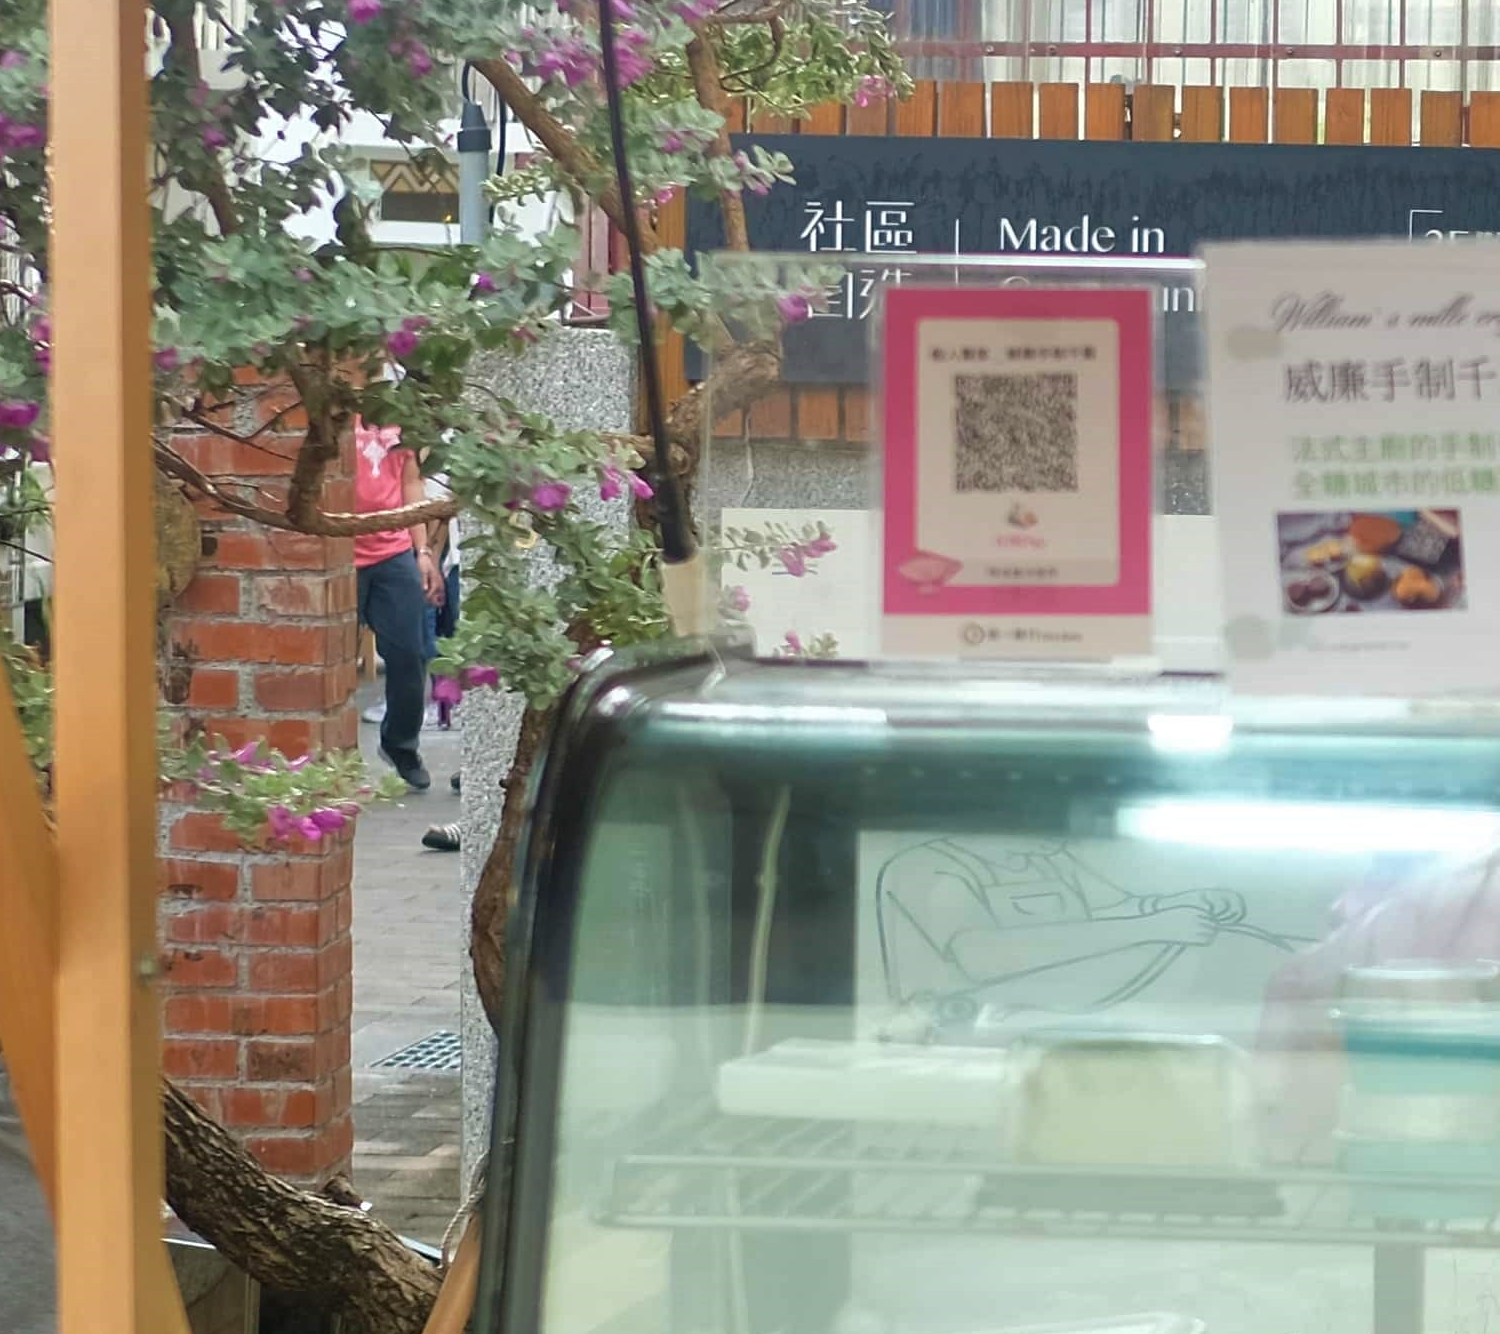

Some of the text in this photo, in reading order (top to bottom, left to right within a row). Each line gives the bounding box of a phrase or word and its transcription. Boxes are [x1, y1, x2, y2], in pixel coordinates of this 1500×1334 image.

[800, 199, 916, 254] 社區
[999, 215, 1166, 254] Made in
